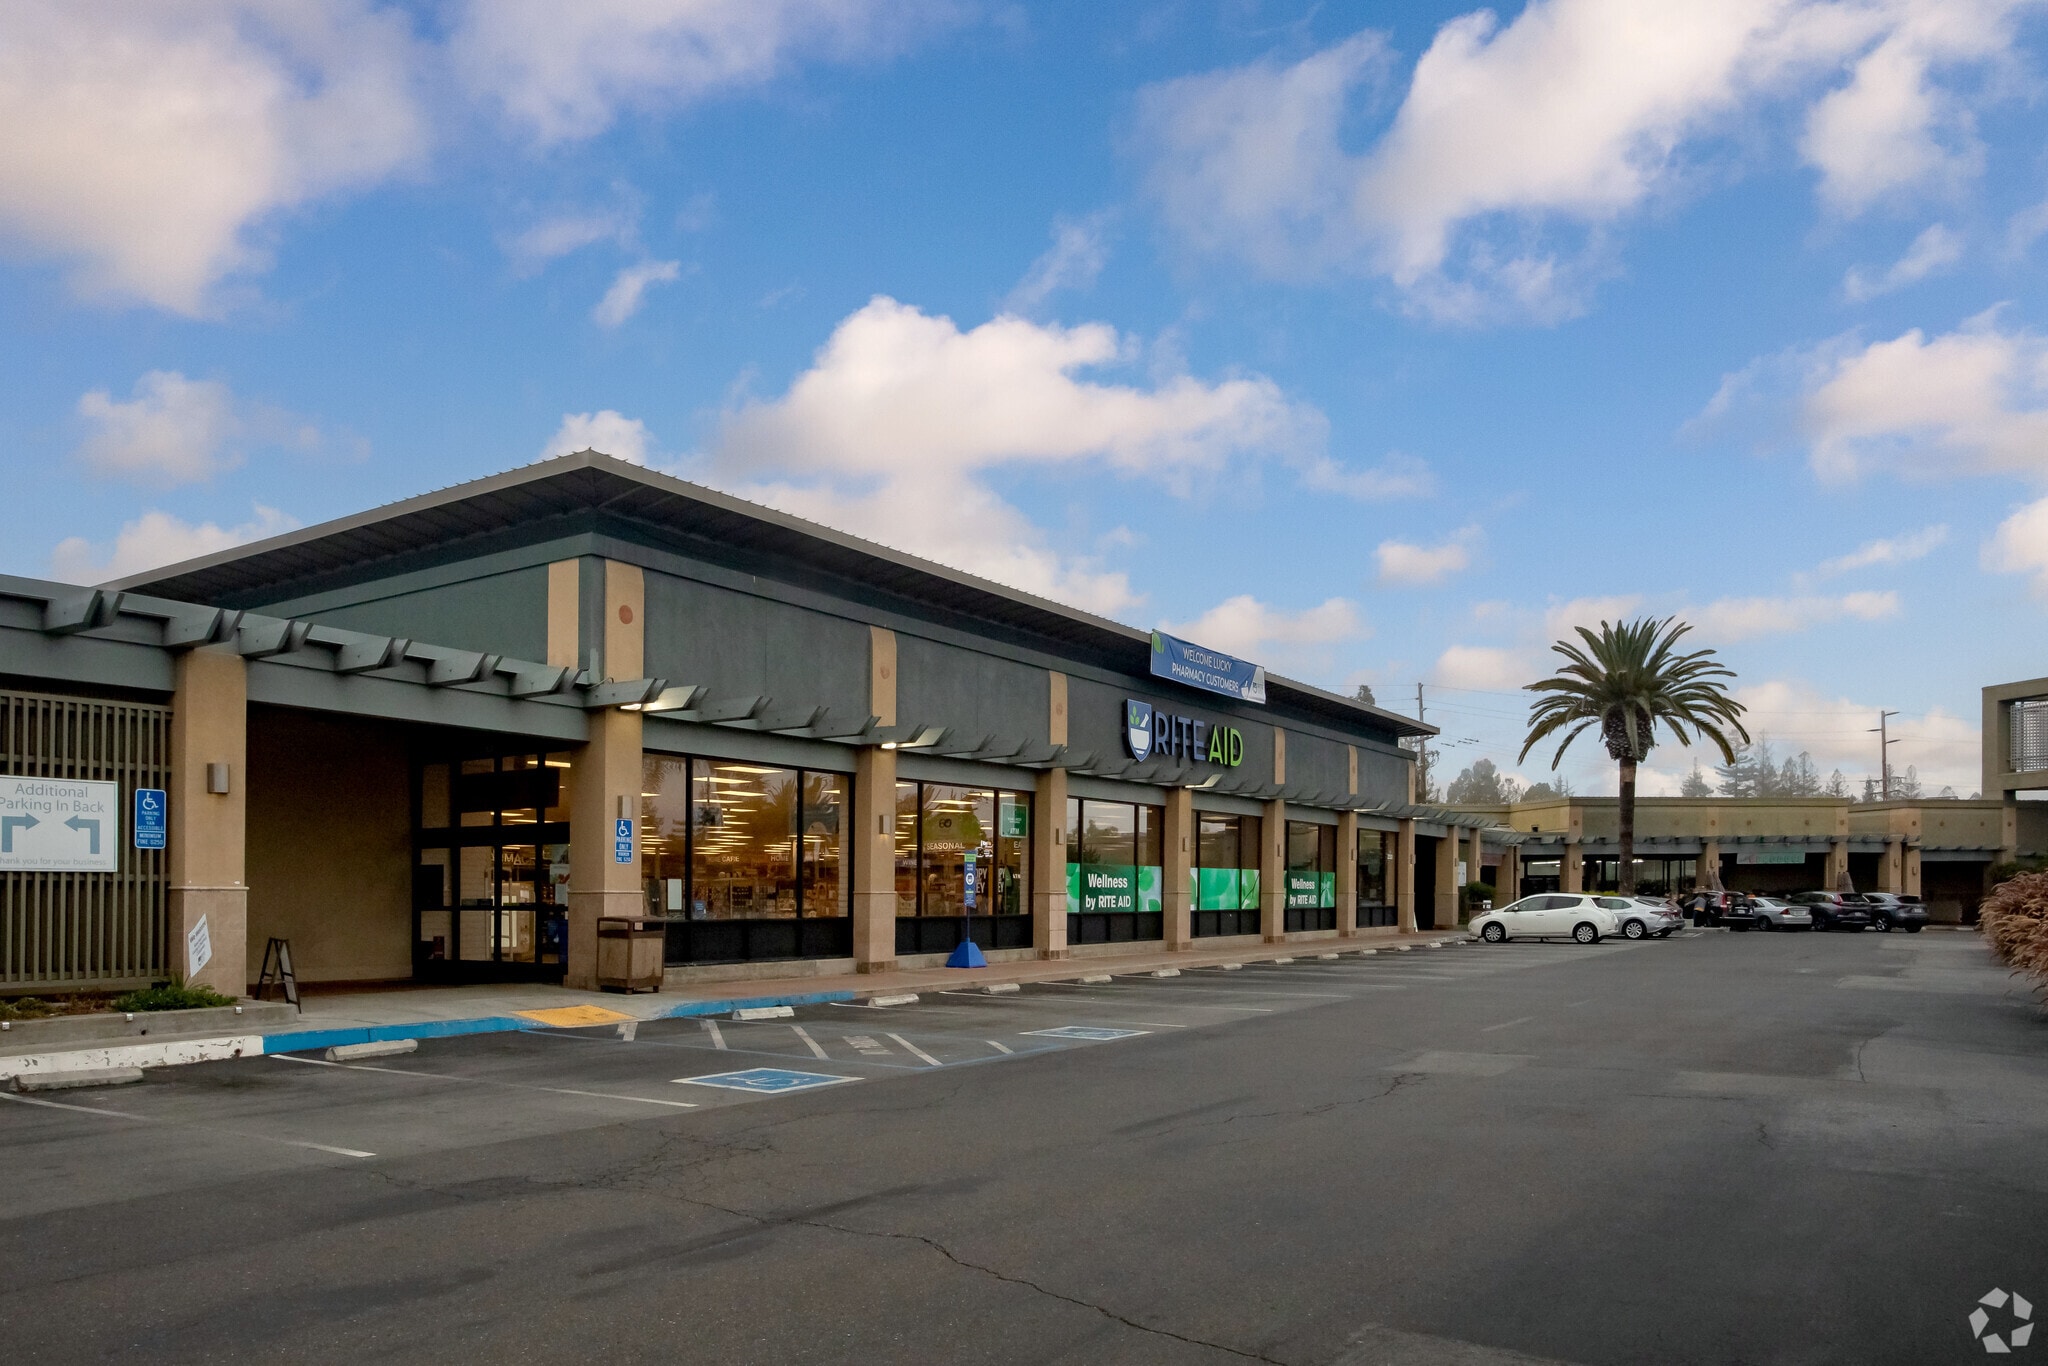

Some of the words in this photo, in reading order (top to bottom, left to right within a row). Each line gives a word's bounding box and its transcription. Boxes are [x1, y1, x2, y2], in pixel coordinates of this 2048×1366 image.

[1182, 647, 1213, 668] WELCOME
[1213, 657, 1233, 673] LUCKY
[1172, 662, 1206, 683] PHARMACY
[1206, 673, 1239, 693] CUSTOMERS
[1155, 711, 1206, 761] RITE
[1208, 724, 1244, 767] AID
[15, 783, 88, 798] Additional
[56, 799, 69, 811] In
[73, 800, 105, 813] Back
[926, 841, 966, 850] SEASONAL
[0, 857, 20, 865] hank
[22, 858, 38, 866] you
[40, 857, 52, 865] for
[52, 859, 71, 867] your
[73, 858, 106, 866] business
[1088, 873, 1128, 888] Wellness
[1291, 878, 1316, 890] Wellness
[1085, 894, 1096, 910] by
[1098, 895, 1117, 908] RITE
[1117, 895, 1131, 908] AID
[1290, 894, 1297, 907] by
[1297, 894, 1308, 905] RITE
[1309, 894, 1317, 905] AID
